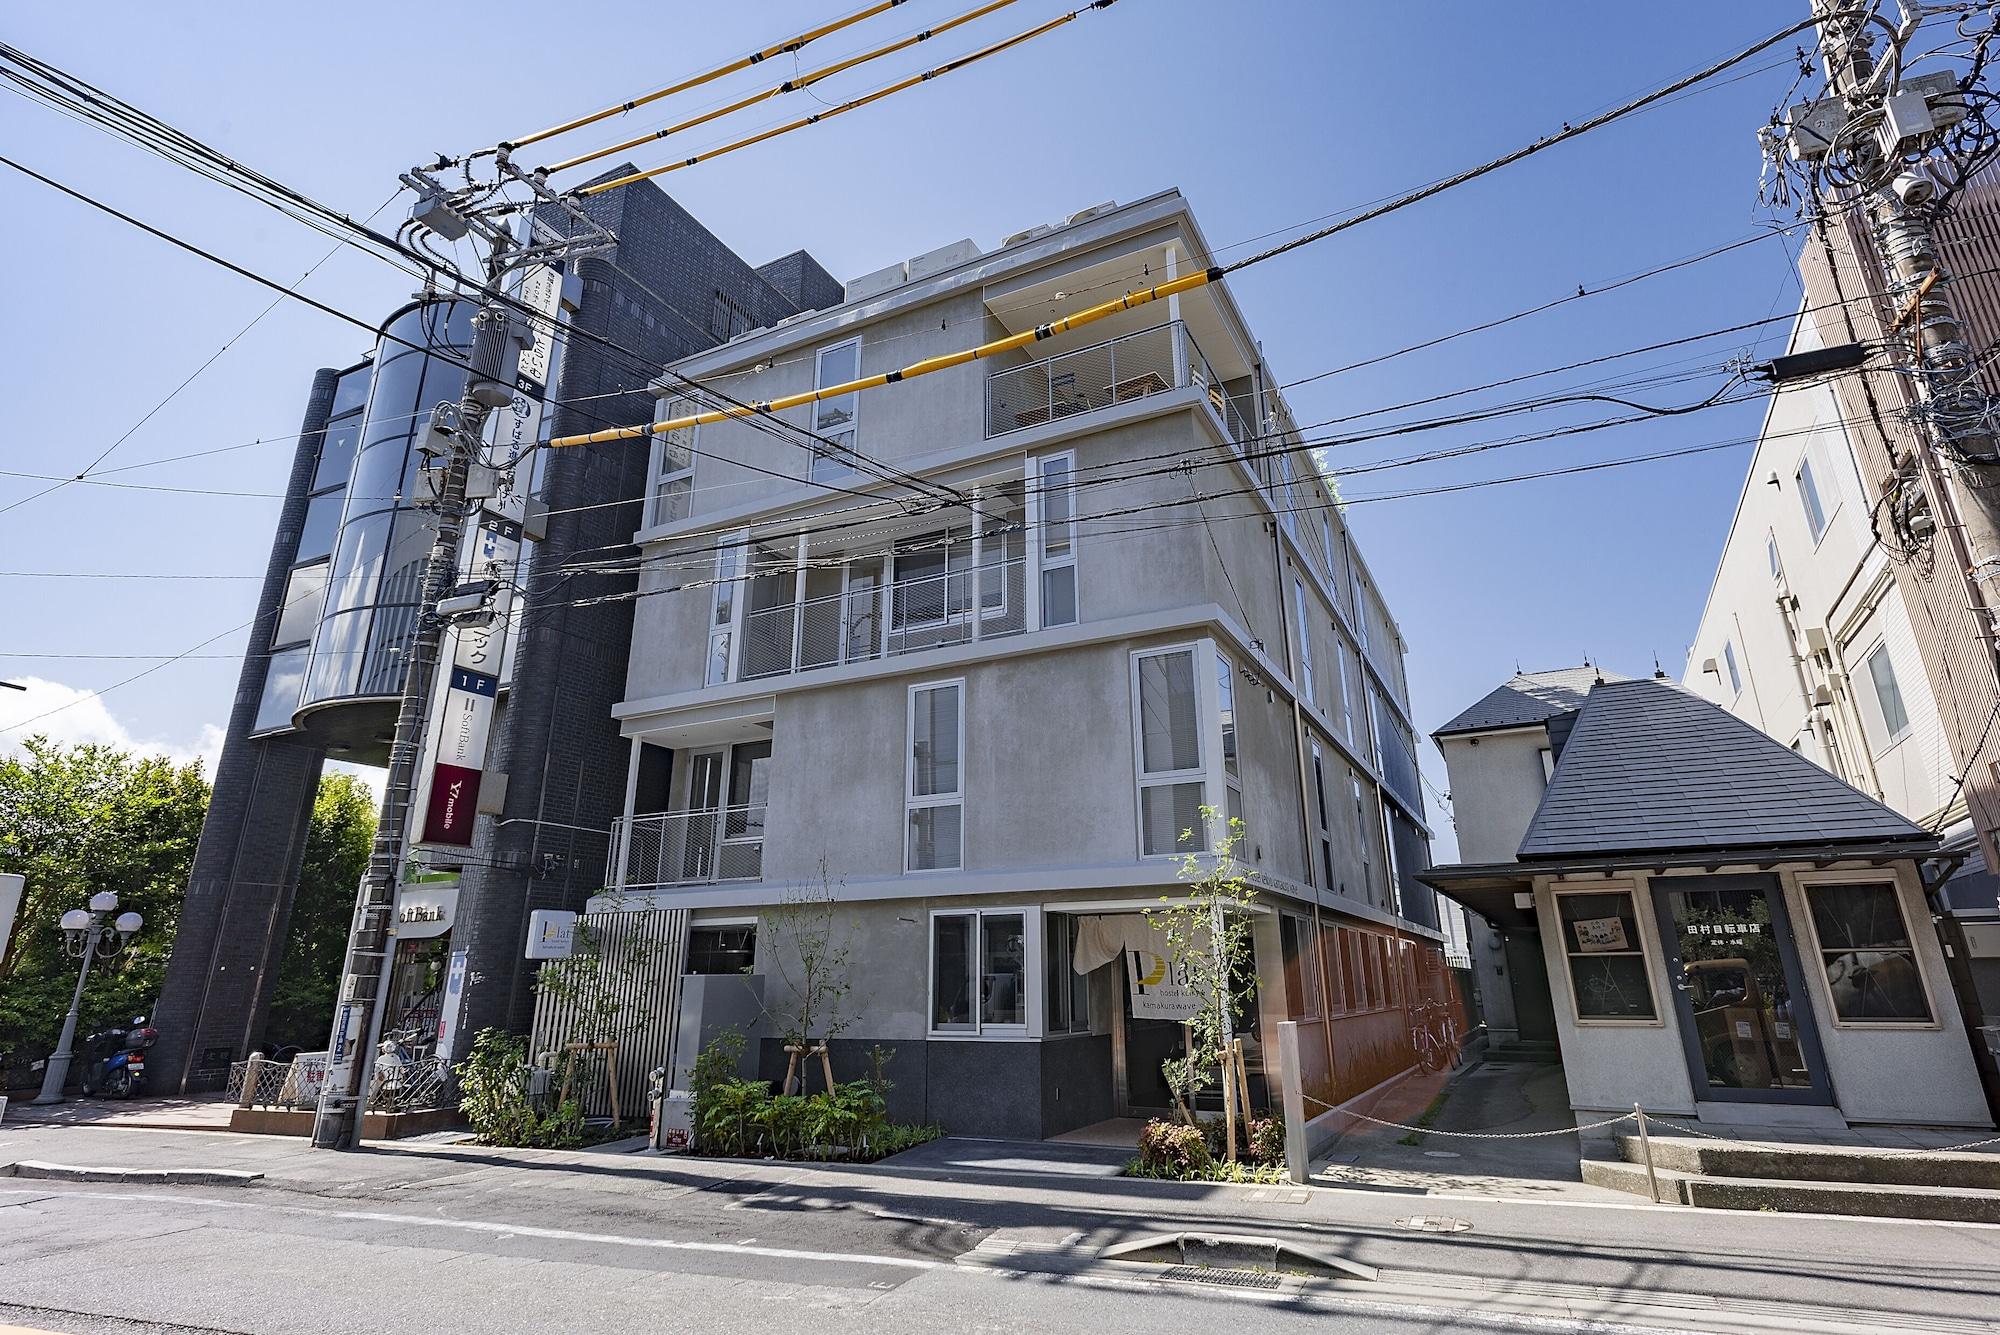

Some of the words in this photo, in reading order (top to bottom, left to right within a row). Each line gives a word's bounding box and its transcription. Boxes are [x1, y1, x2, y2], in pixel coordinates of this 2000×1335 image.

[518, 378, 533, 392] 3F
[455, 713, 473, 761] SoftBank
[399, 904, 446, 923] oftBank
[1687, 923, 1761, 935] 田村自転車店
